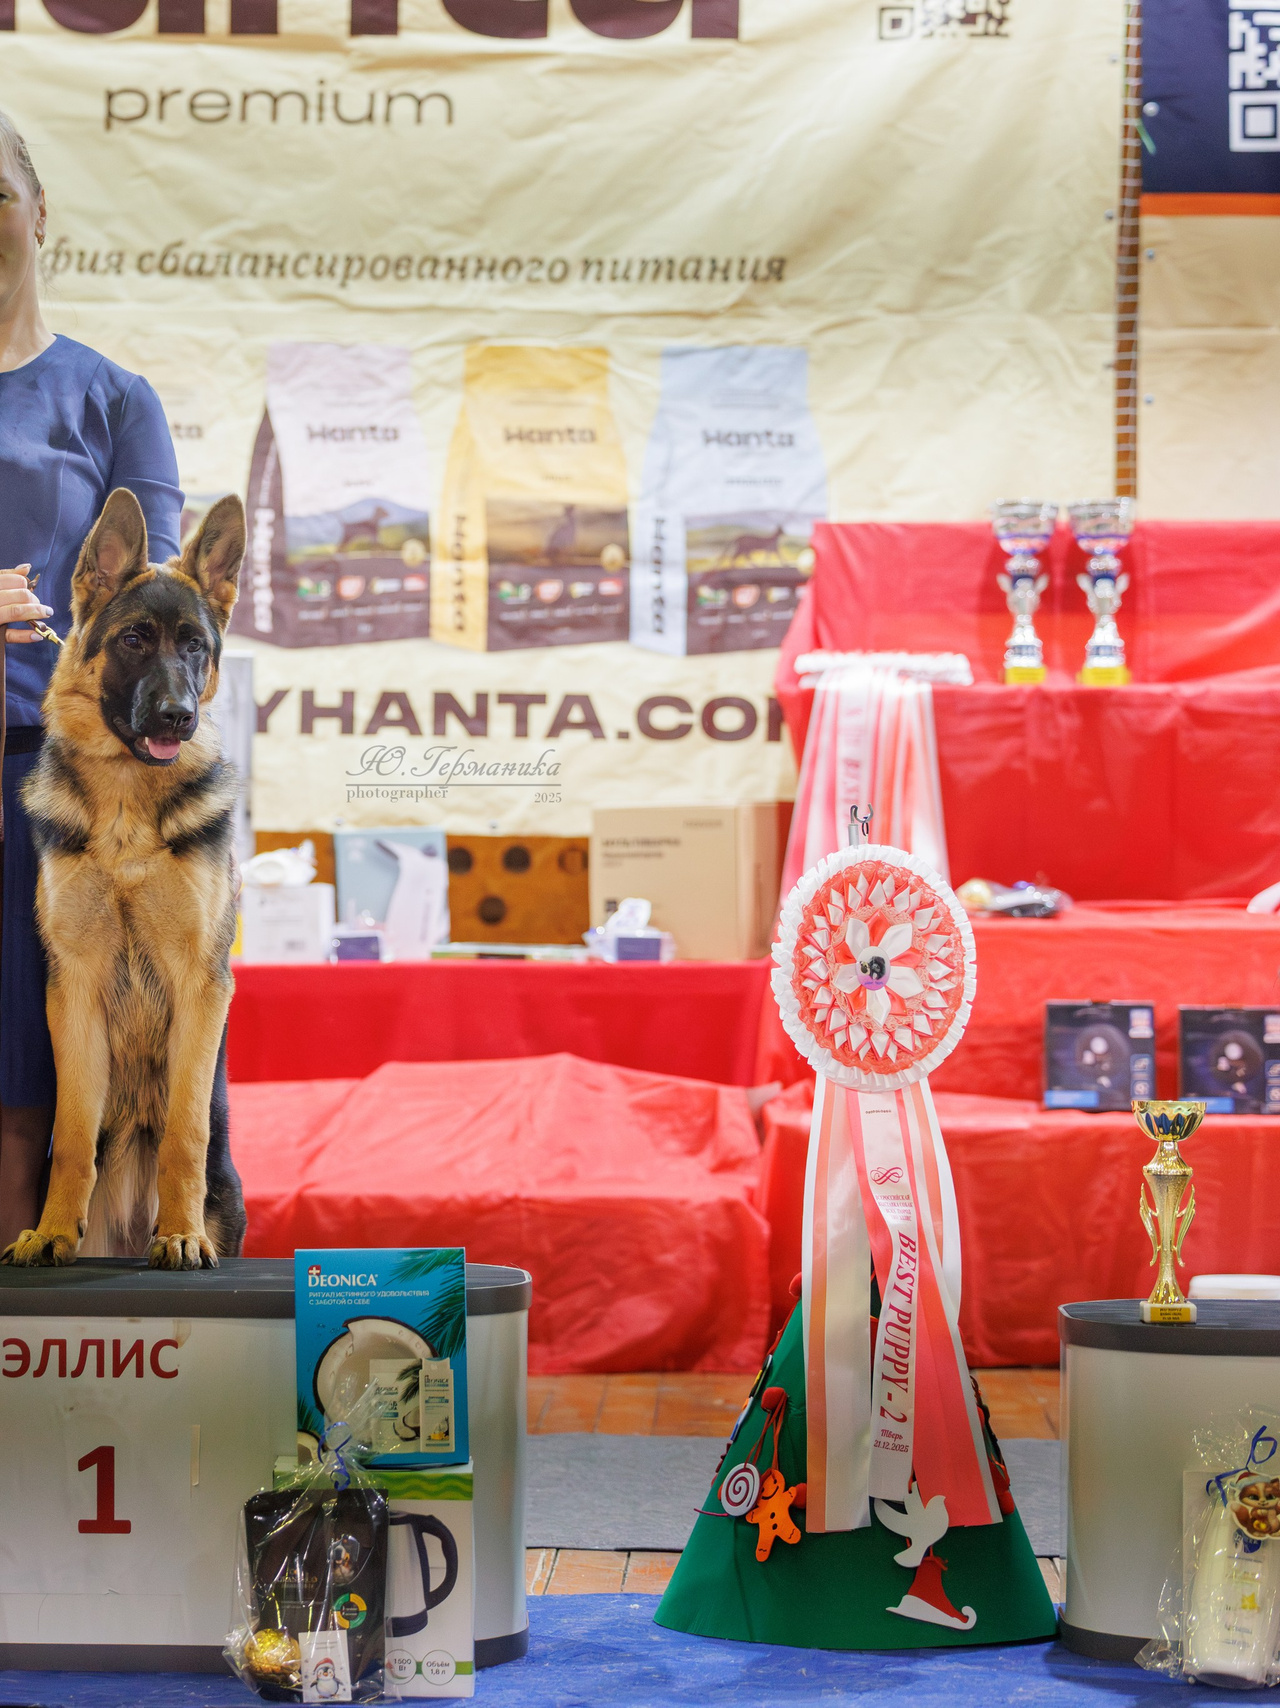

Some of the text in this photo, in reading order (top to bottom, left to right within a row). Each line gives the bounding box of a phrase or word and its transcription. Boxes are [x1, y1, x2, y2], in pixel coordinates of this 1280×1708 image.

[104, 79, 454, 131] premium
[136, 239, 570, 288] сбалансированного
[581, 254, 787, 284] питания
[306, 423, 401, 443] Hanta
[503, 426, 597, 444] Hanta
[702, 428, 795, 449] Hanta
[253, 689, 784, 743] YHANTA.CO
[893, 1229, 917, 1304] BEST
[307, 1273, 378, 1288] DEONICA
[315, 1297, 347, 1305] ЗАБОТОЙ
[336, 1290, 376, 1298] ИСТИННОГО
[377, 1289, 430, 1297] УДОВОЛЬСТВИЯ
[881, 1301, 913, 1394] PUPPY
[2, 1337, 179, 1380] ЭЛЛИС
[879, 1405, 908, 1424] 2
[880, 1428, 904, 1440] Тверь
[873, 1439, 910, 1453] 21.12.2025
[77, 1445, 132, 1535] 1
[426, 1660, 450, 1668] Объём
